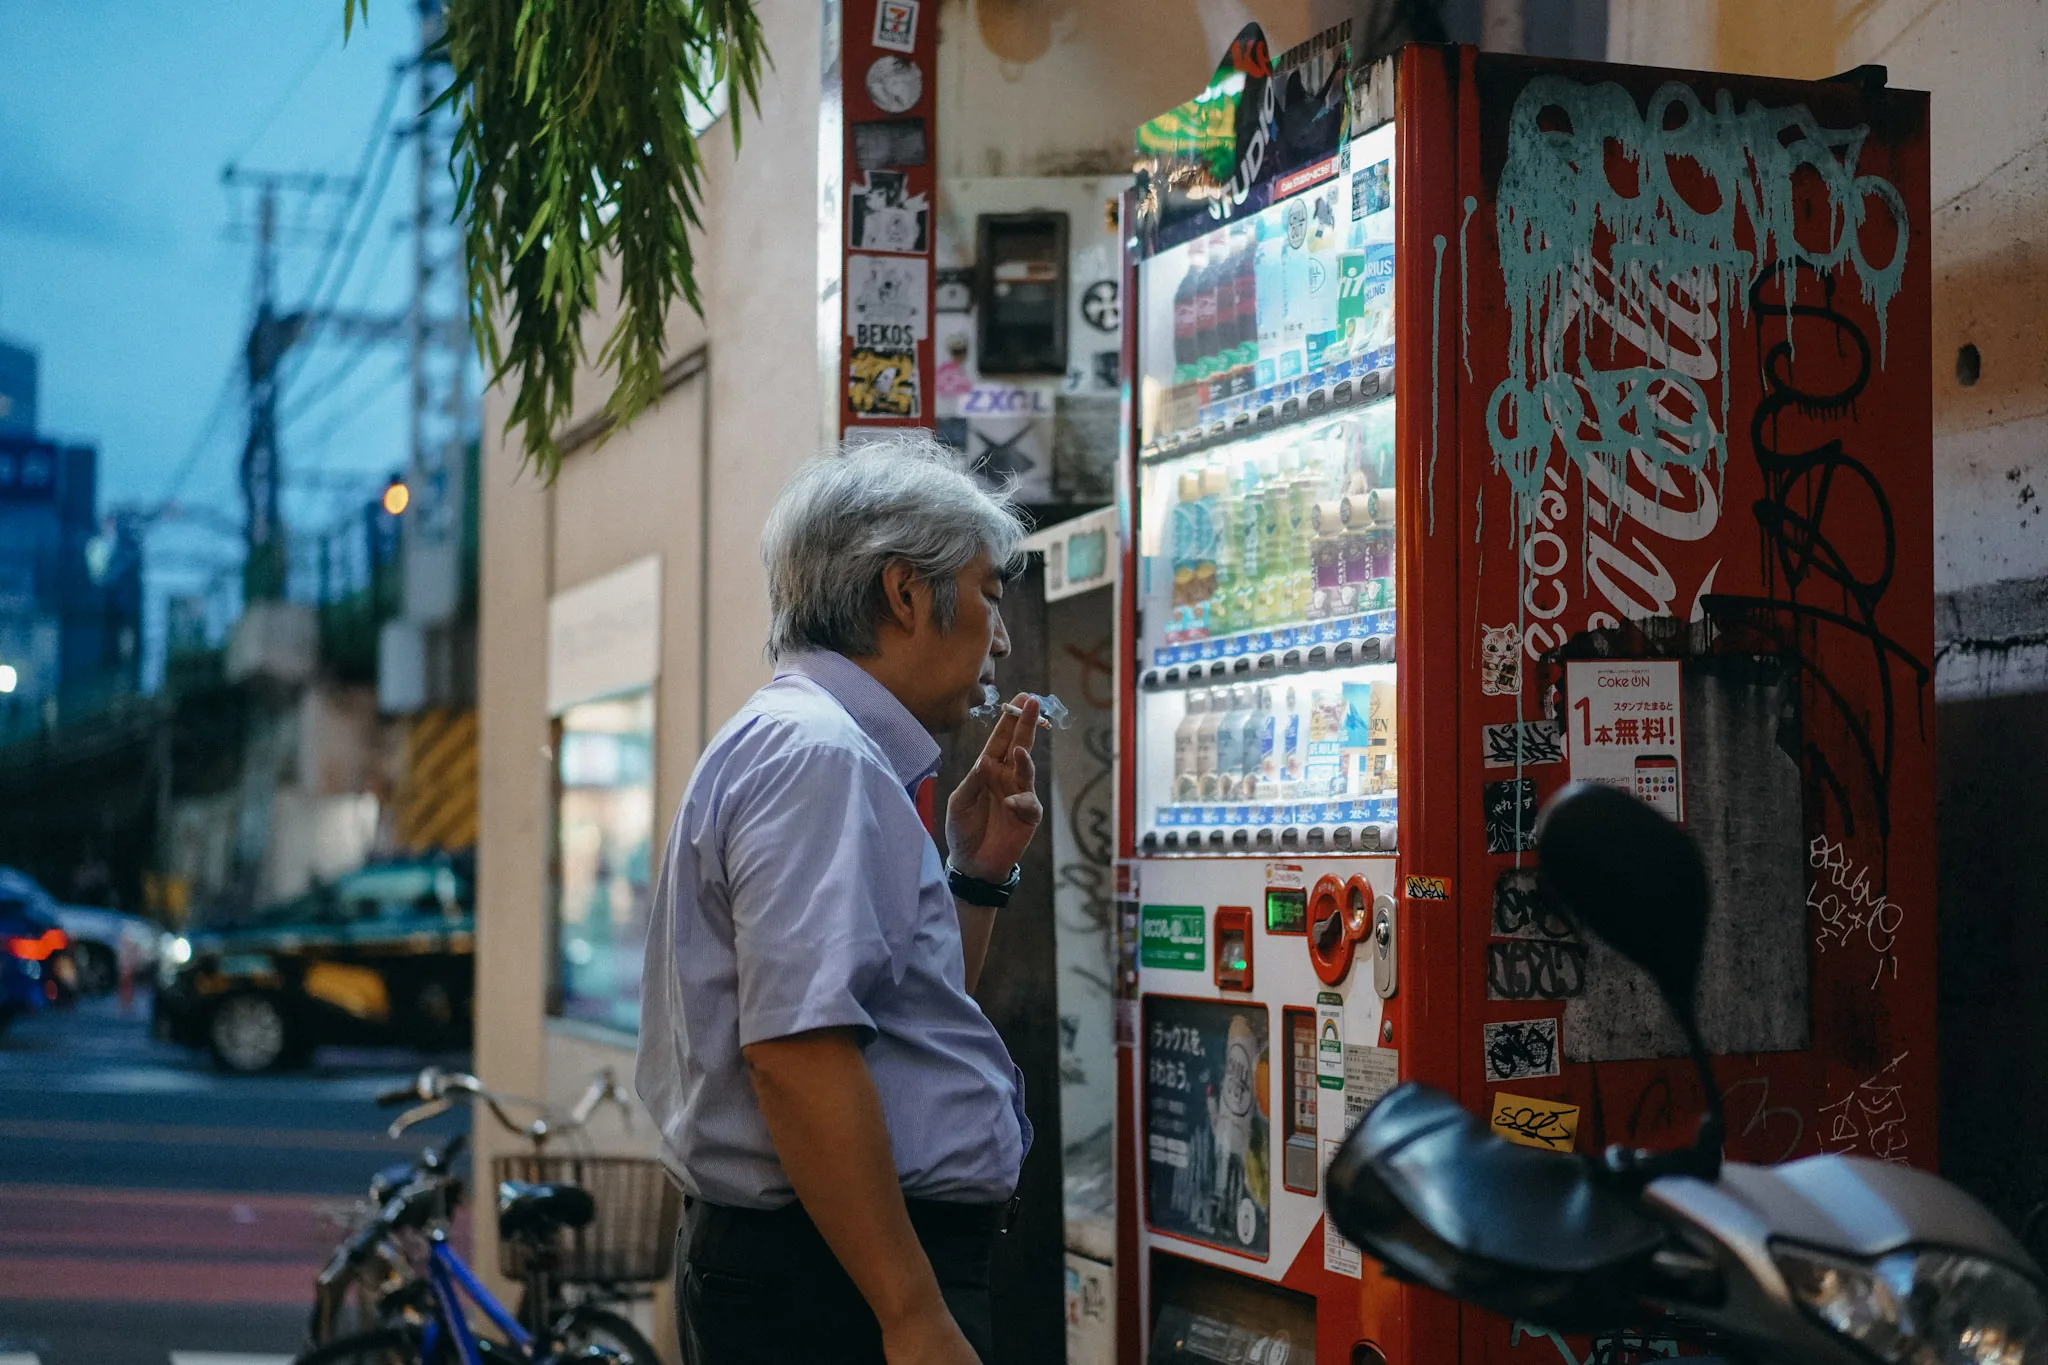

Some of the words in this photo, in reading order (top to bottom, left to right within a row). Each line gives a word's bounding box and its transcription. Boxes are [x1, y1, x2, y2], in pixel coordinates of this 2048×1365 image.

[857, 324, 914, 346] BEKOS
[1597, 676, 1629, 688] Coke
[1631, 675, 1650, 687] ON
[1614, 702, 1674, 711] スタンプたまると
[1152, 1021, 1206, 1057] ラックスを、
